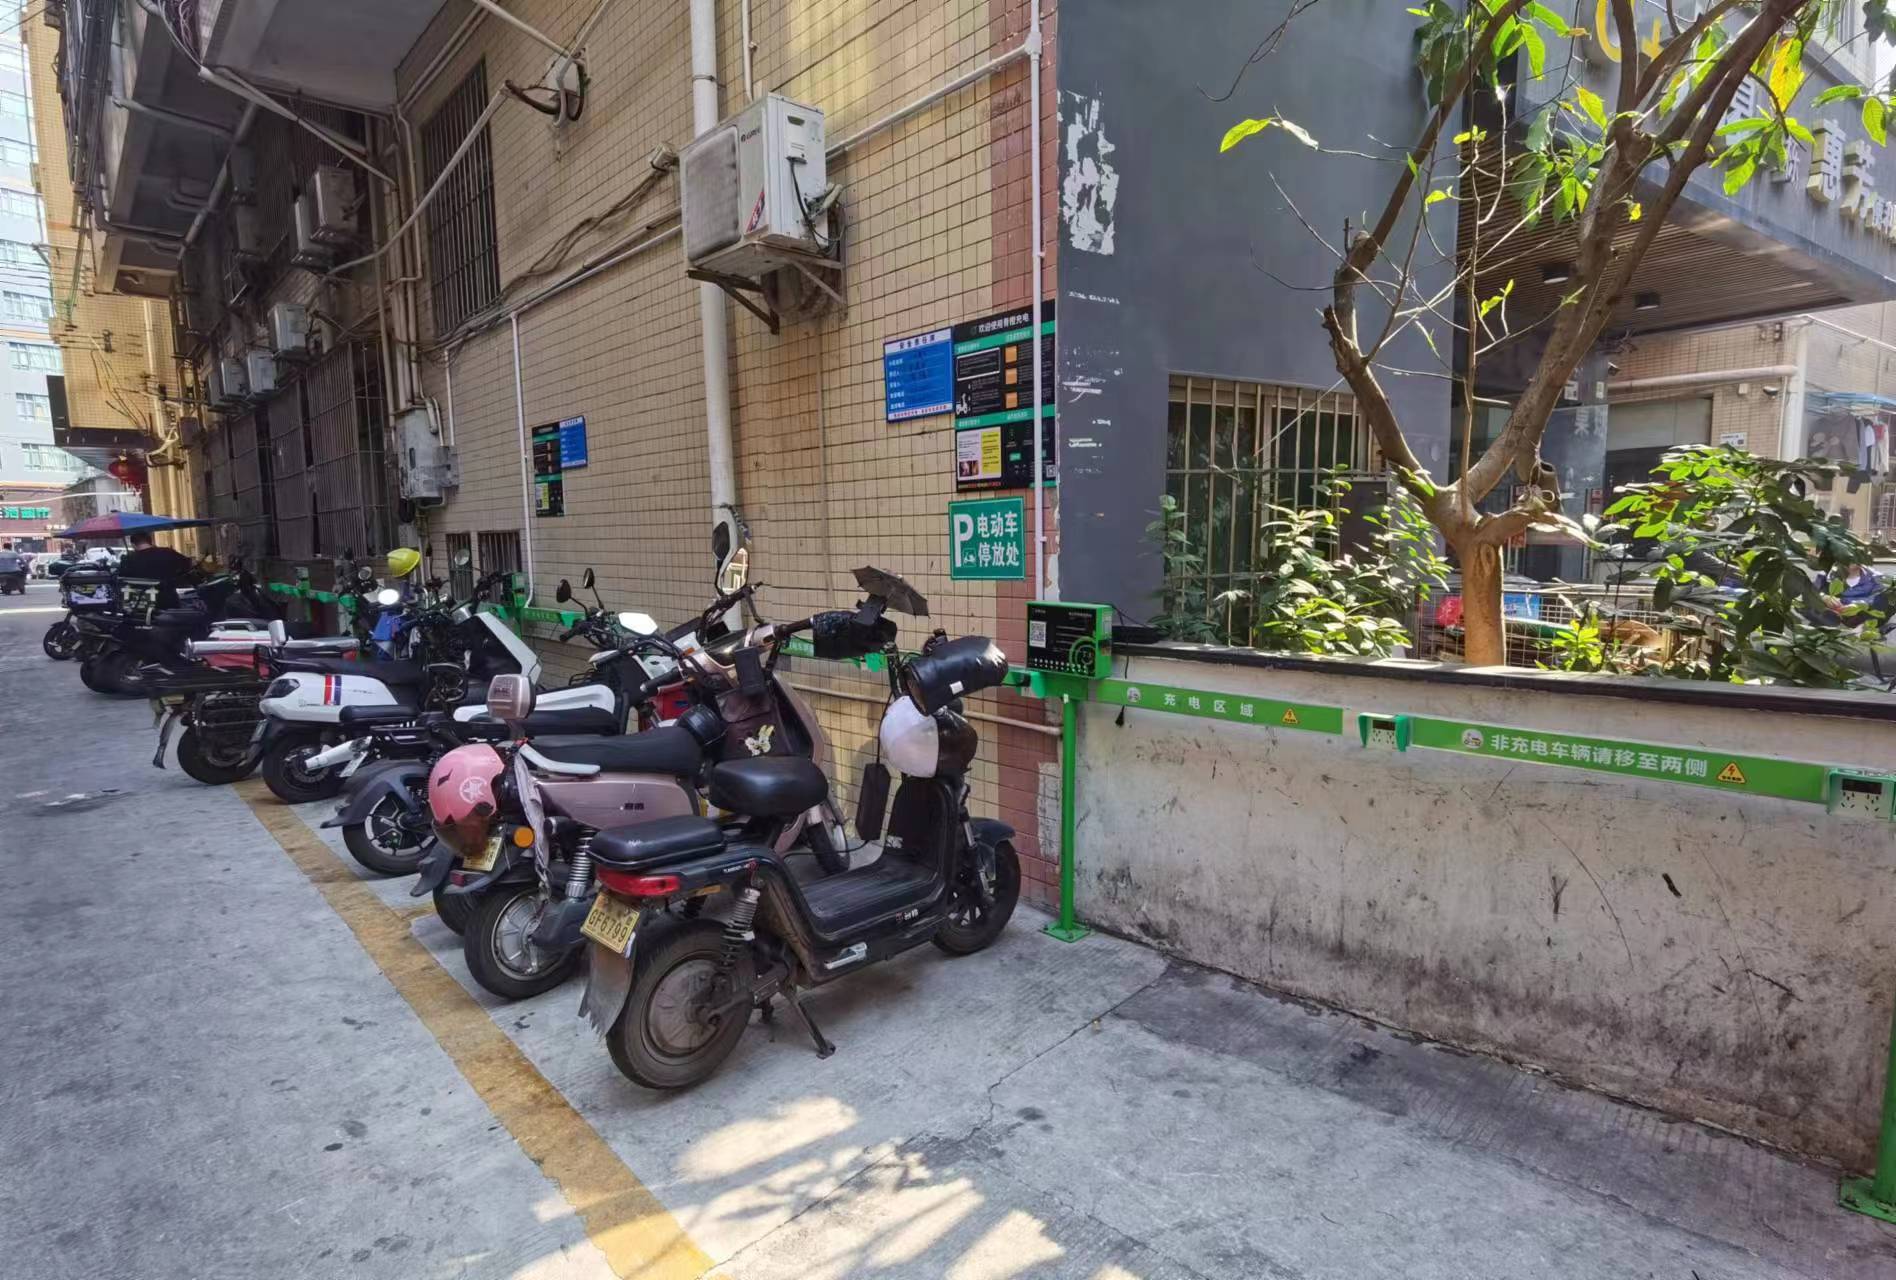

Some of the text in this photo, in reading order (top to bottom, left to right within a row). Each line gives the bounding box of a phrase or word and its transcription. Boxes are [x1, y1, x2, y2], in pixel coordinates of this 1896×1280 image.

[977, 510, 1018, 538] 电动车
[953, 513, 974, 568] P
[978, 541, 1020, 568] 停放处
[1163, 693, 1254, 718] 充电区域
[1490, 733, 1708, 778] 非充电车辆请移至两侧
[588, 908, 628, 943] GF6799
